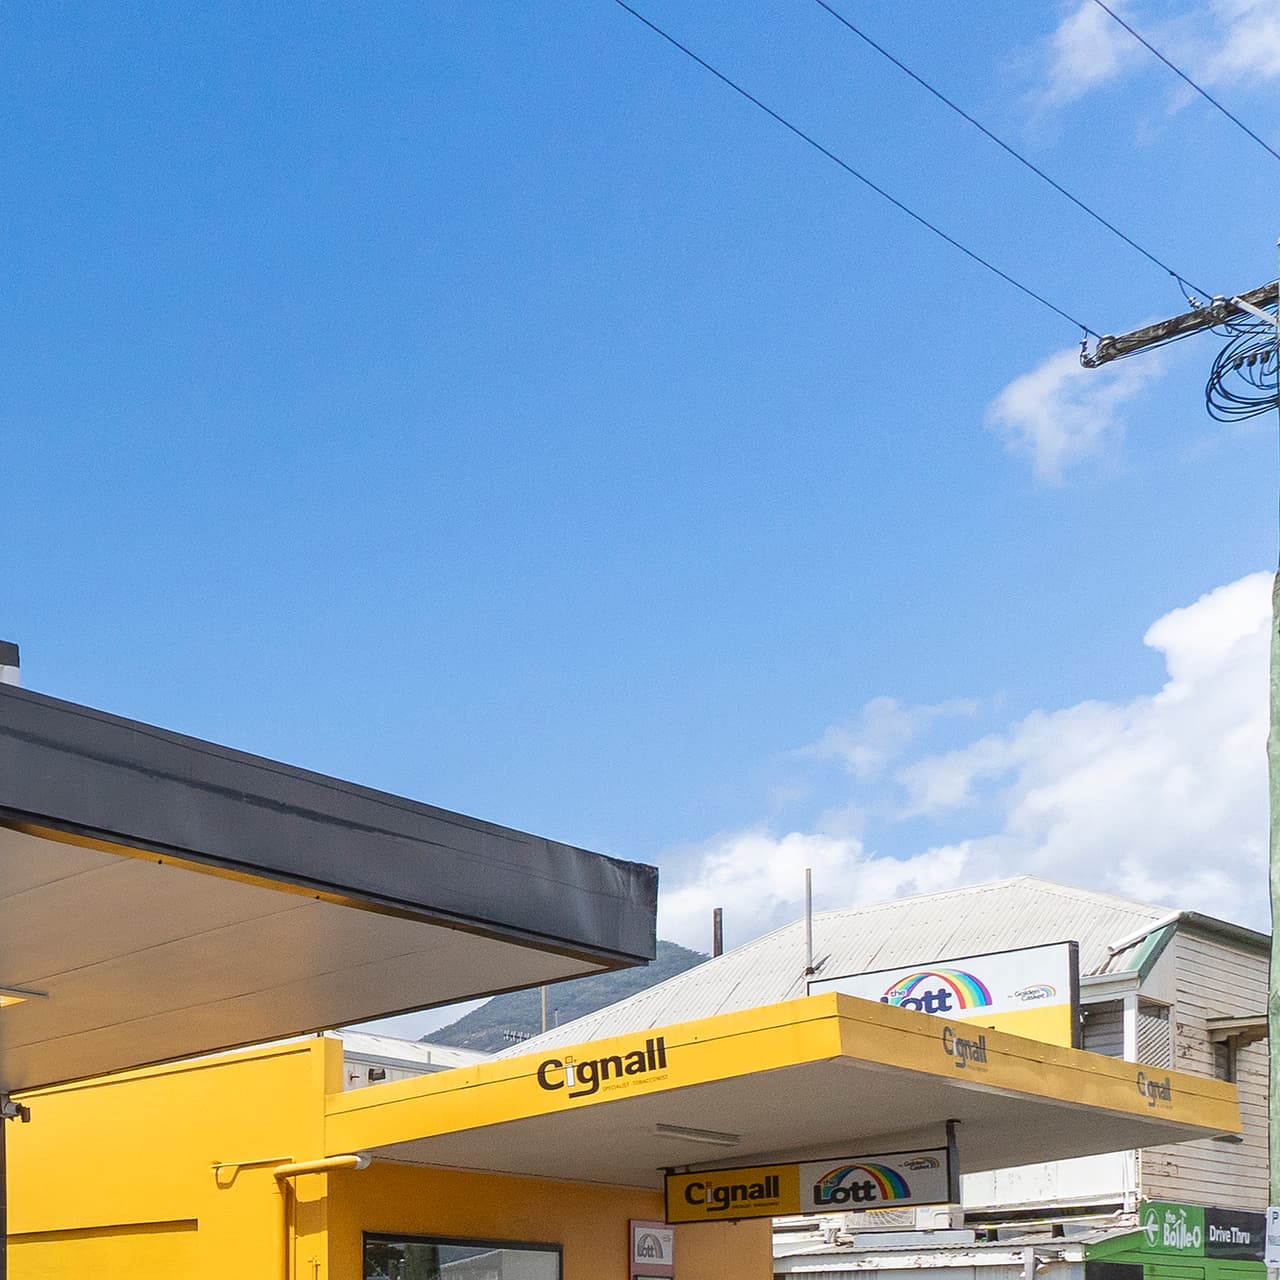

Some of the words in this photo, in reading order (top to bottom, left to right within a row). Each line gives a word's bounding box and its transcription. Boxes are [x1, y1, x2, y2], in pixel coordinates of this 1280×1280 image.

[537, 1036, 667, 1099] Cignall
[684, 1175, 780, 1212] Cignall
[813, 1180, 877, 1206] Lott
